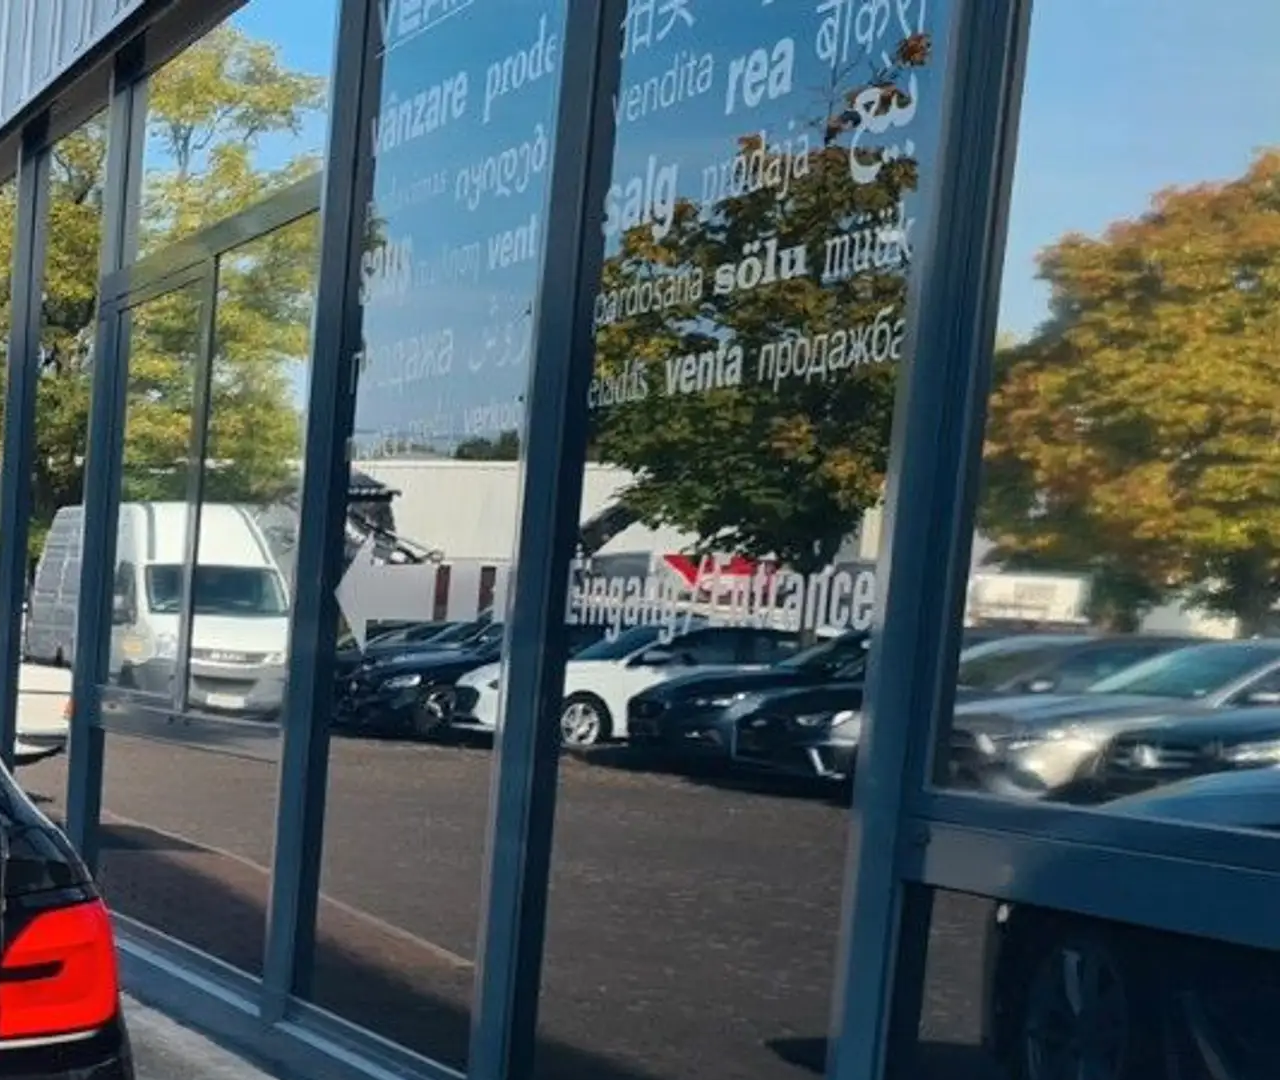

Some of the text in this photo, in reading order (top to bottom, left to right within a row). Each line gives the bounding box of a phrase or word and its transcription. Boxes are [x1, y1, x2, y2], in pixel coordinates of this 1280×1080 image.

[612, 37, 795, 126] vendita rea
[602, 118, 810, 239] salg prodaja
[713, 232, 810, 296] sölu
[663, 340, 744, 396] venta
[757, 305, 906, 392] продажба
[564, 557, 677, 646] Eingang
[708, 556, 878, 634] Entrance
